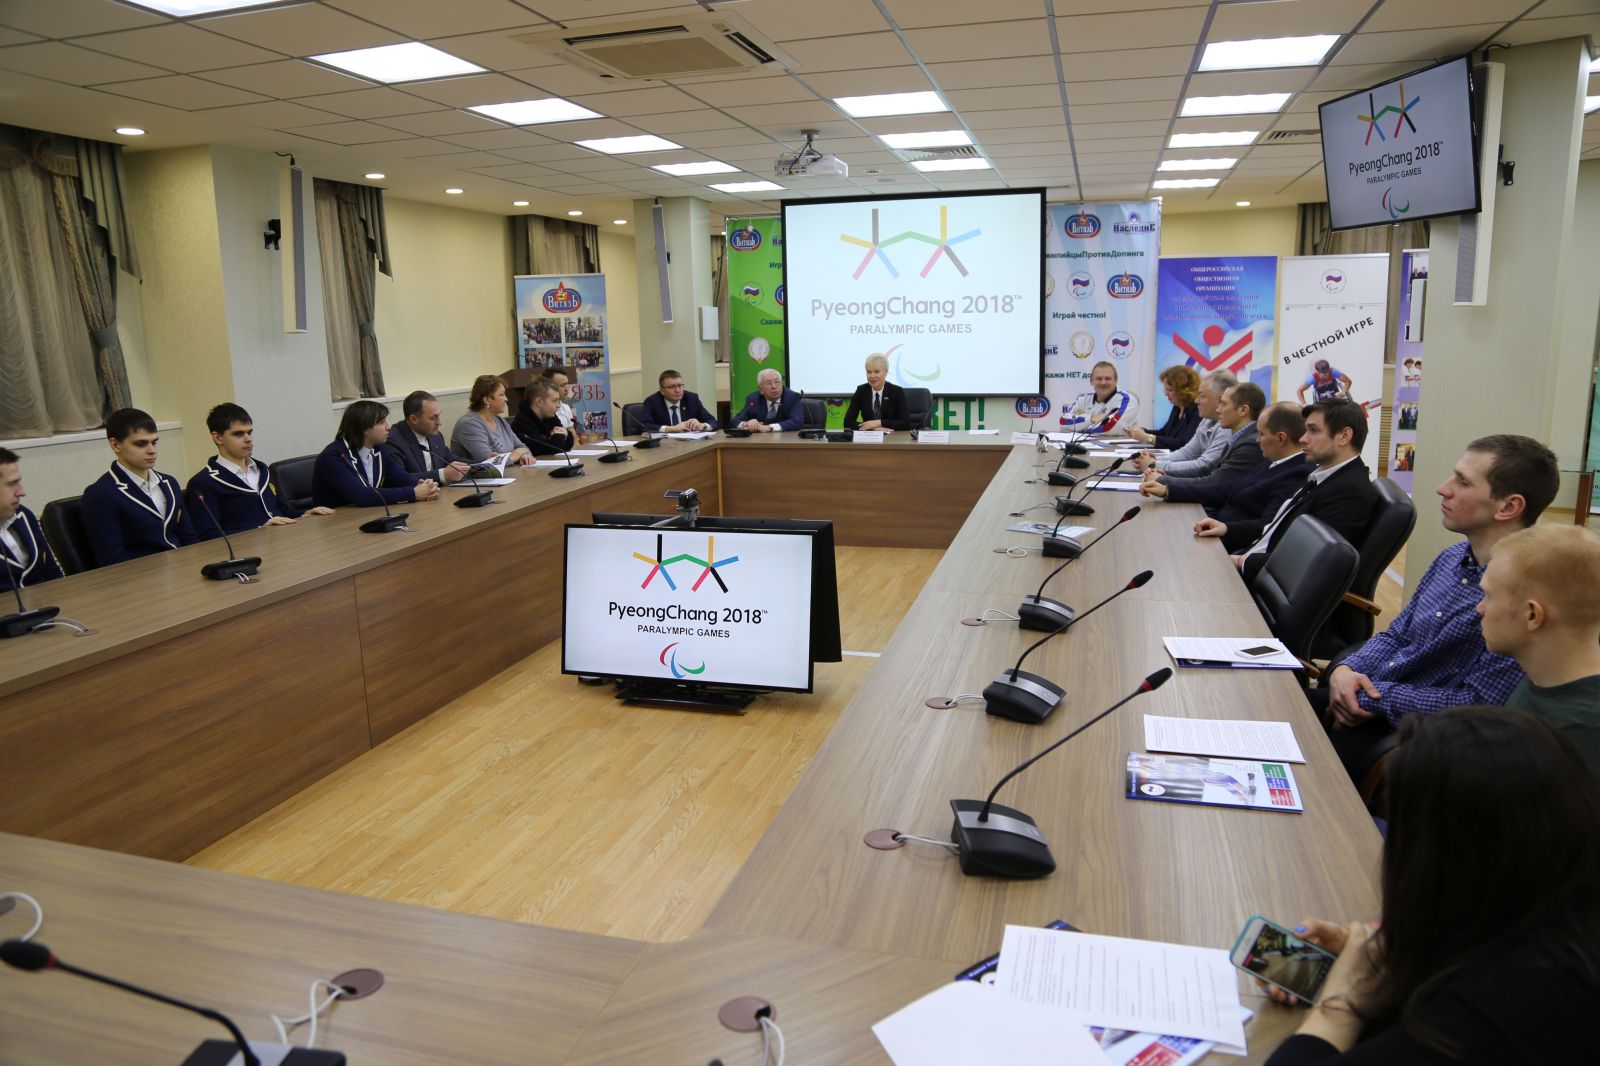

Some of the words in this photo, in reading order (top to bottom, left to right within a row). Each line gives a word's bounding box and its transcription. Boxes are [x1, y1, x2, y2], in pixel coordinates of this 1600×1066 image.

[1349, 151, 1412, 176] PyeongChang
[1366, 171, 1400, 184] PARALYMPIC
[1401, 167, 1422, 178] GAMES
[811, 296, 956, 320] PyeongChang
[850, 323, 925, 335] PARALYMPIC
[928, 323, 973, 334] GAMES
[1283, 355, 1291, 365] В
[1291, 329, 1345, 361] ЧЕСТНОЙ
[1345, 316, 1374, 336] ИГРЕ
[1066, 371, 1081, 379] НЕТ
[571, 384, 606, 401] ЯЗЬ
[608, 601, 718, 625] PyeongChang
[637, 624, 694, 636] PARALYMPIC
[697, 628, 730, 638] GAMES
